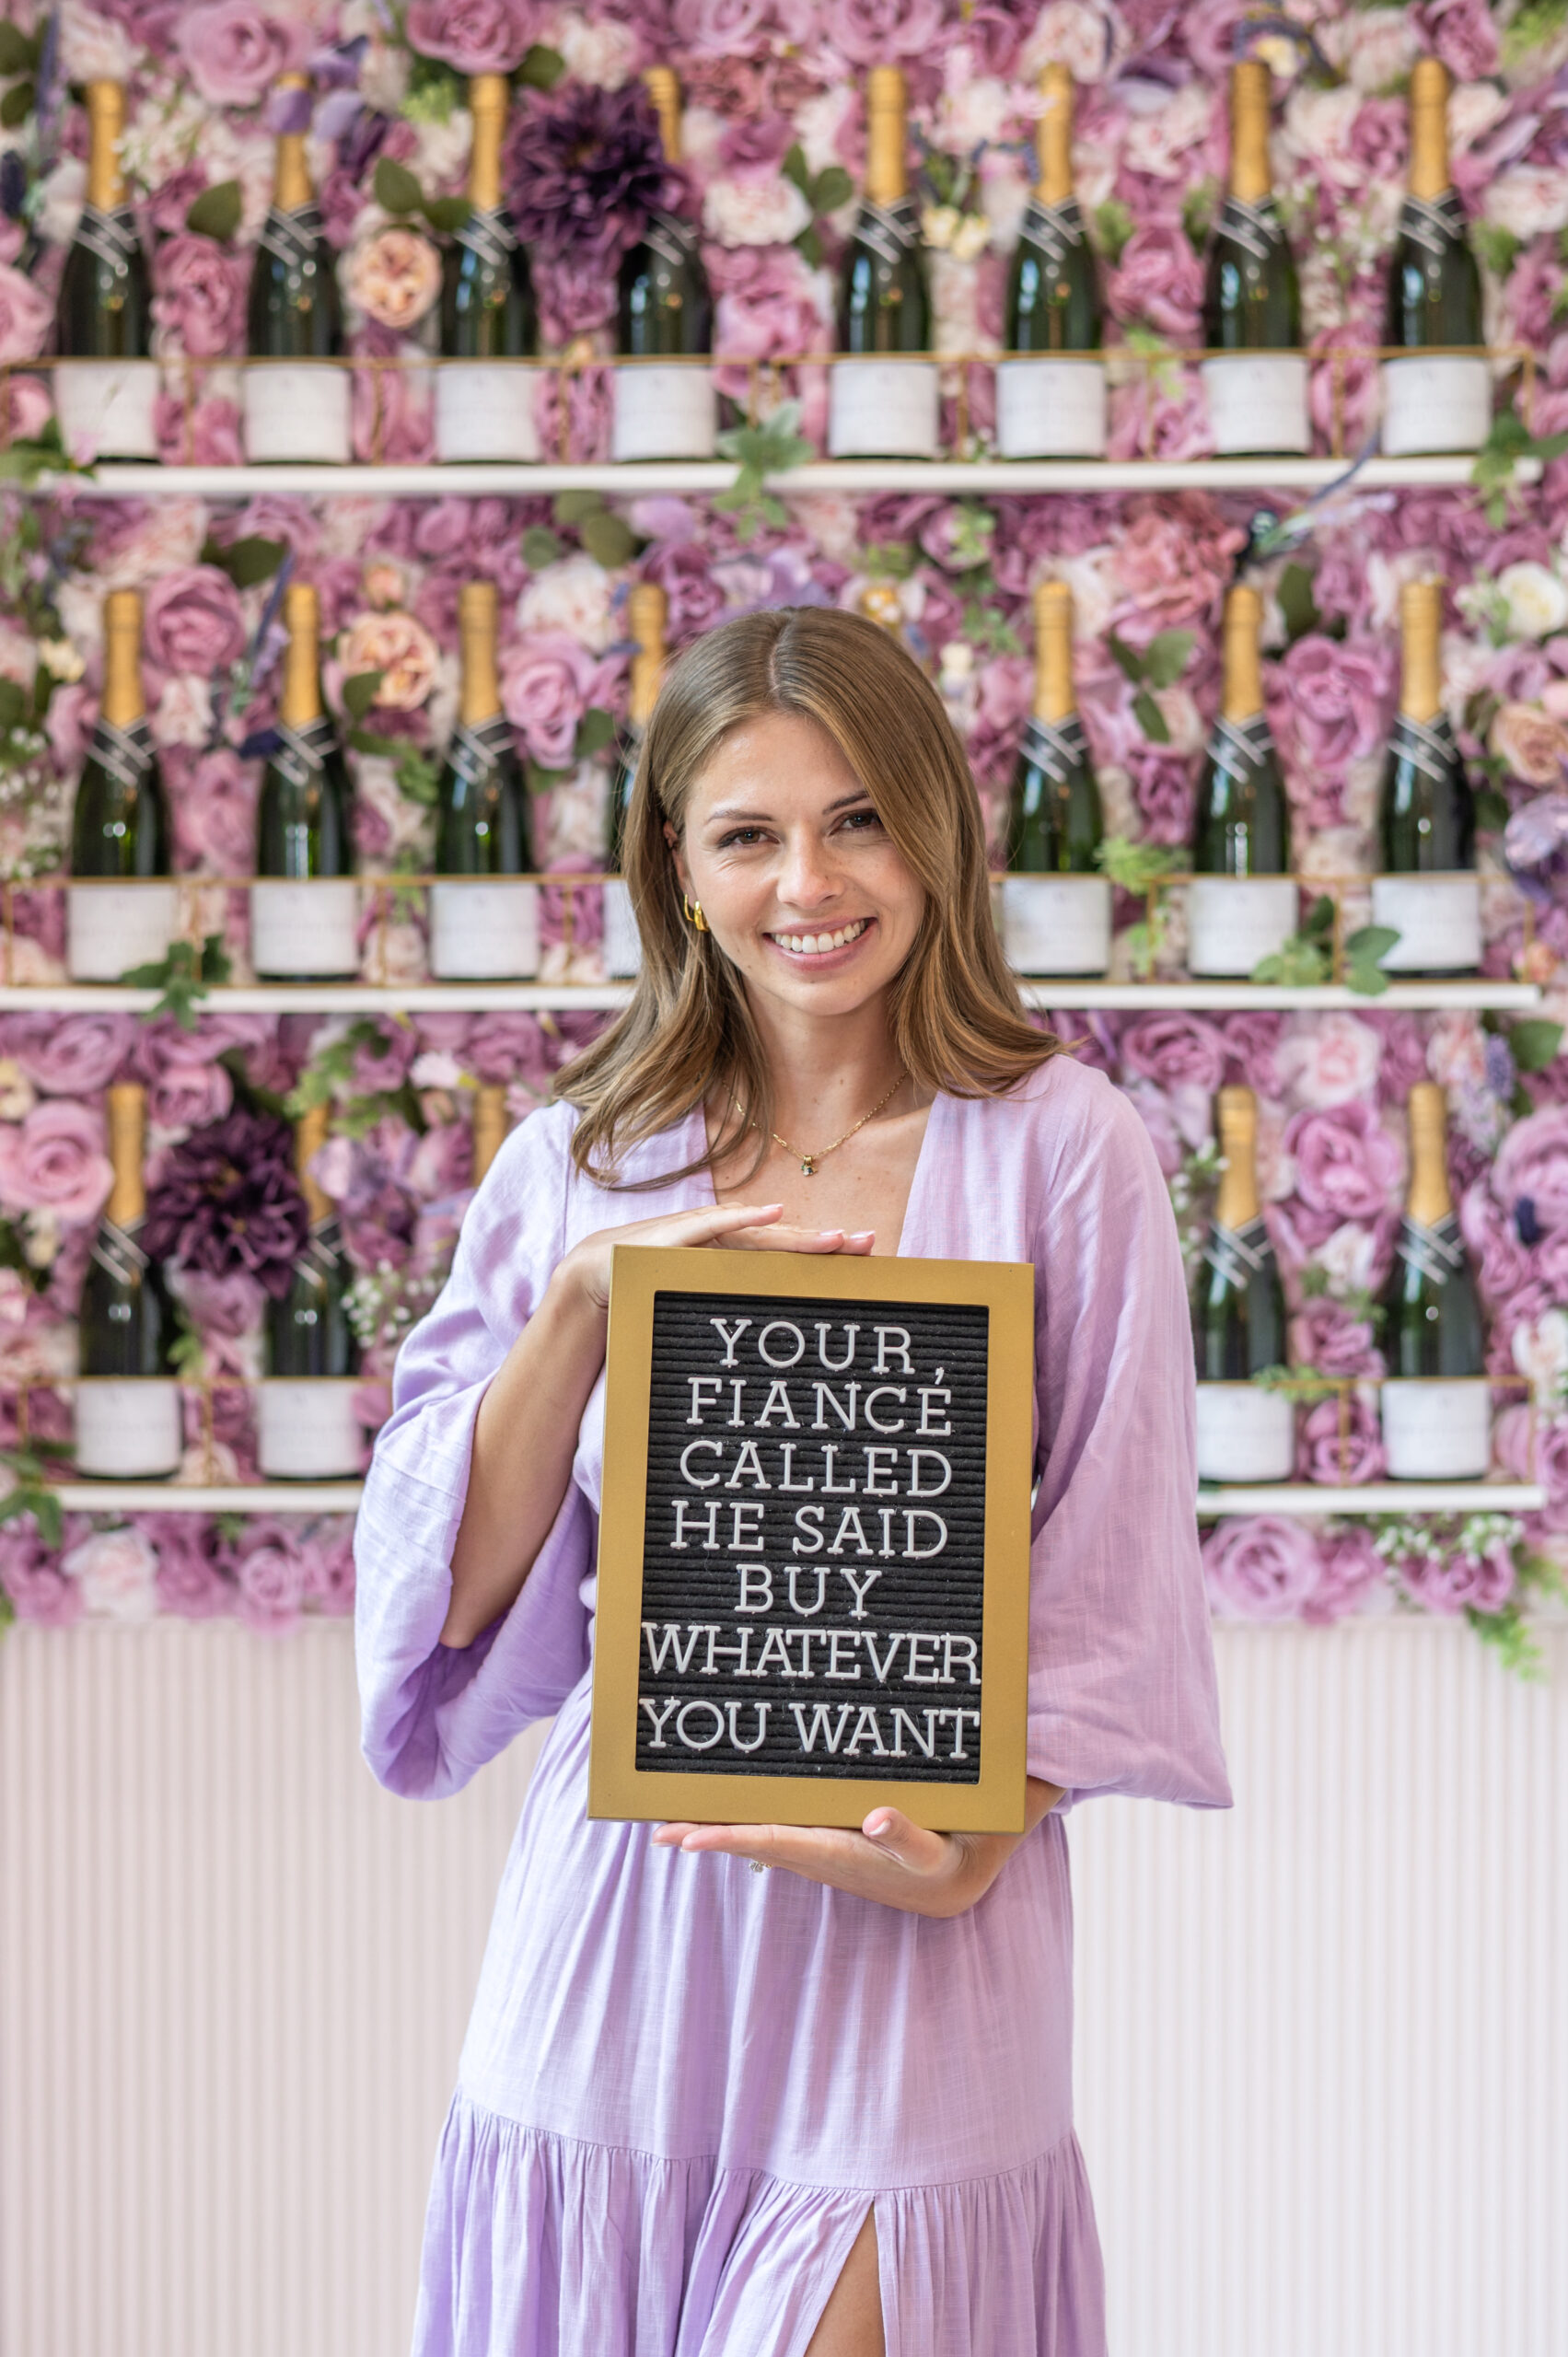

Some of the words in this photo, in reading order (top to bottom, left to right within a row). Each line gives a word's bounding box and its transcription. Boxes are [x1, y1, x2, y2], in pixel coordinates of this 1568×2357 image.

[679, 1440, 952, 1498] CALLED
[670, 1501, 764, 1551] HE
[793, 1505, 948, 1559] SAID
[735, 1563, 881, 1618] BUY
[641, 1622, 981, 1685] WHATEVER
[638, 1697, 772, 1751] YOU
[790, 1703, 980, 1759] WANT
